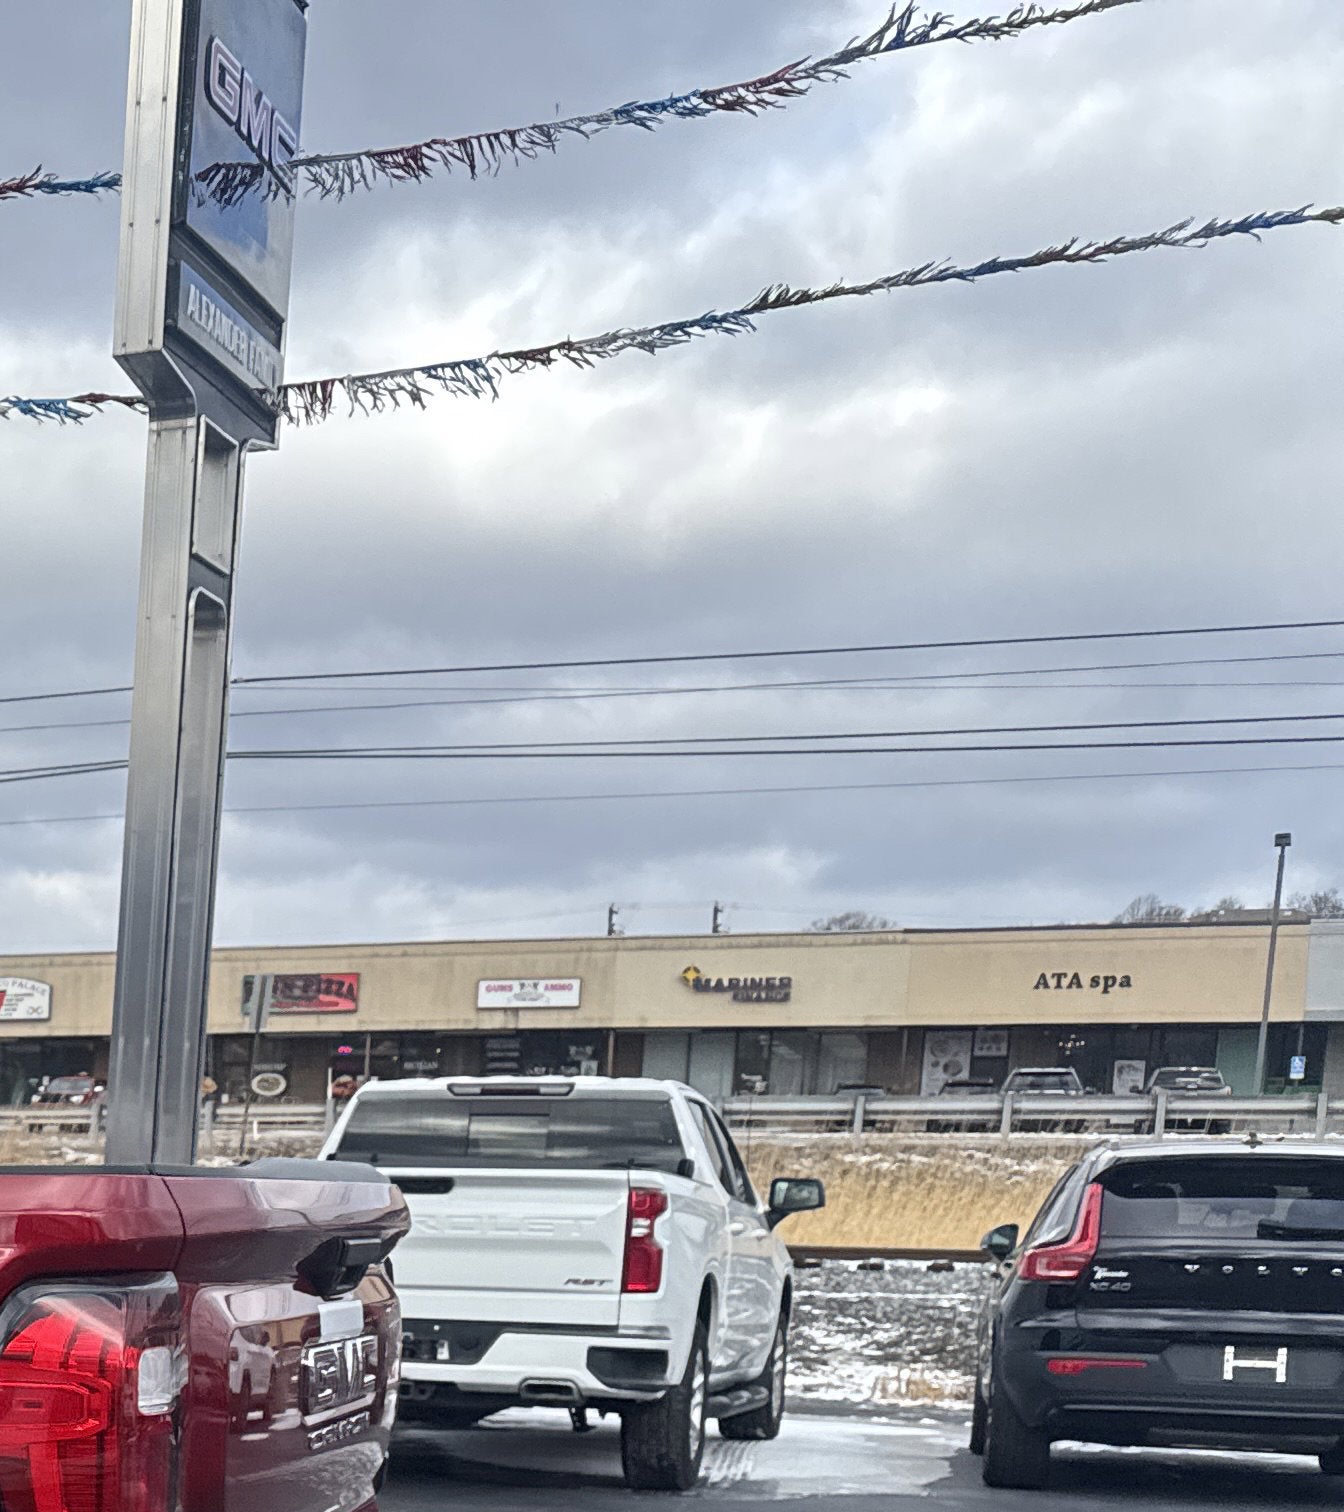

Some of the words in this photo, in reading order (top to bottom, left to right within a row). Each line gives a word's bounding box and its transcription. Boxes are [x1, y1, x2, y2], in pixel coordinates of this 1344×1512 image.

[206, 36, 297, 193] GMC
[186, 283, 245, 366] ALEXANDER
[11, 978, 48, 996] PALACE
[485, 983, 513, 993] GUNS
[543, 982, 574, 992] AMMO
[694, 976, 792, 992] MARINER
[1033, 972, 1083, 989] ATA
[1089, 974, 1132, 994] spa
[1183, 1263, 1344, 1277] VOLVO
[307, 1335, 379, 1414] GMC
